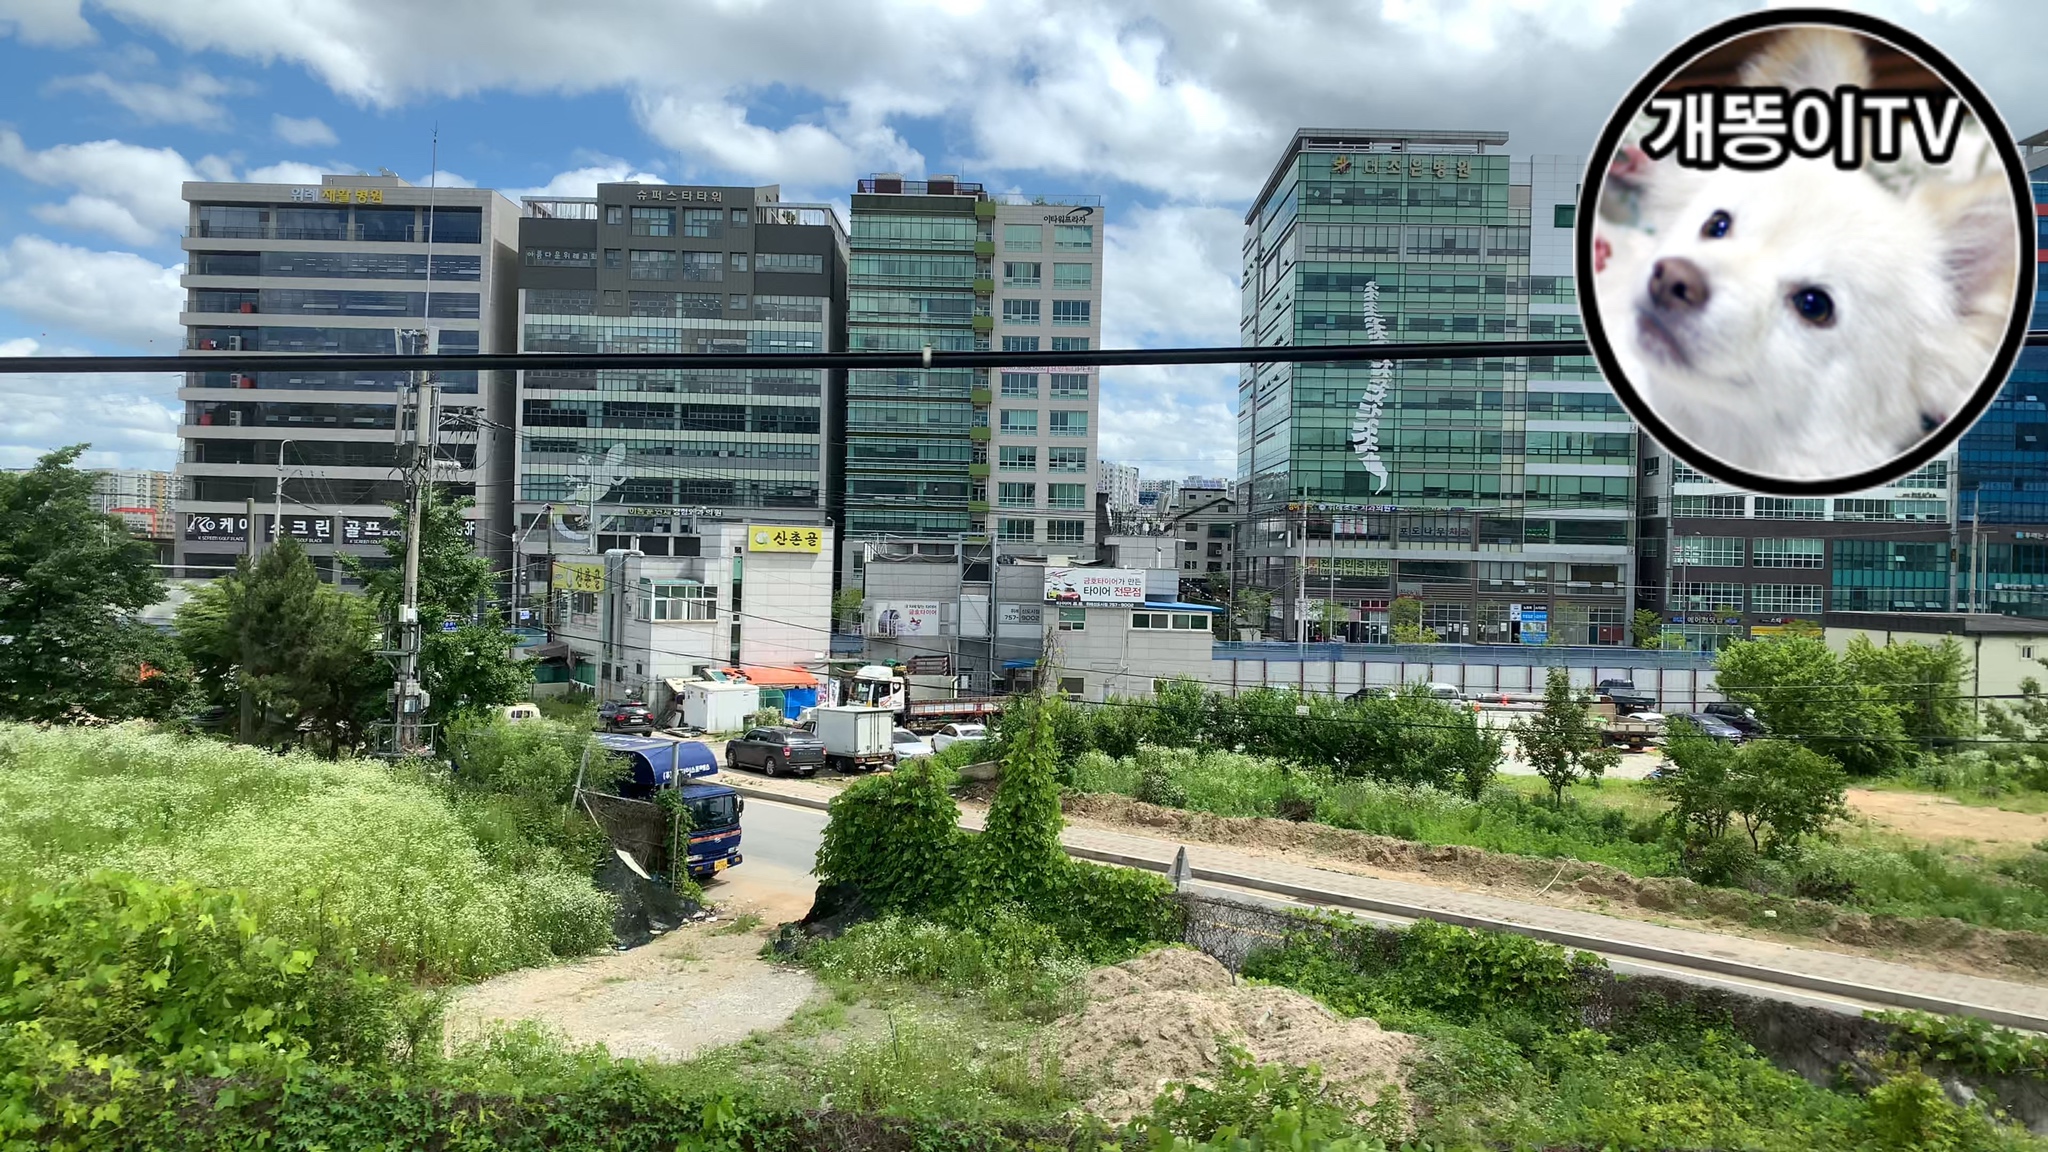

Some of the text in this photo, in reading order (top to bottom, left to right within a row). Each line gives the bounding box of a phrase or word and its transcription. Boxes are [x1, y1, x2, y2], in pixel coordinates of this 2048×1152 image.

[322, 188, 351, 203] 재활
[355, 189, 383, 204] 병원
[636, 189, 723, 203] 슈퍼스타타워
[773, 530, 819, 547] 산촌골
[576, 567, 601, 590] 산촌골
[1083, 586, 1142, 597] 타이어 전문점
